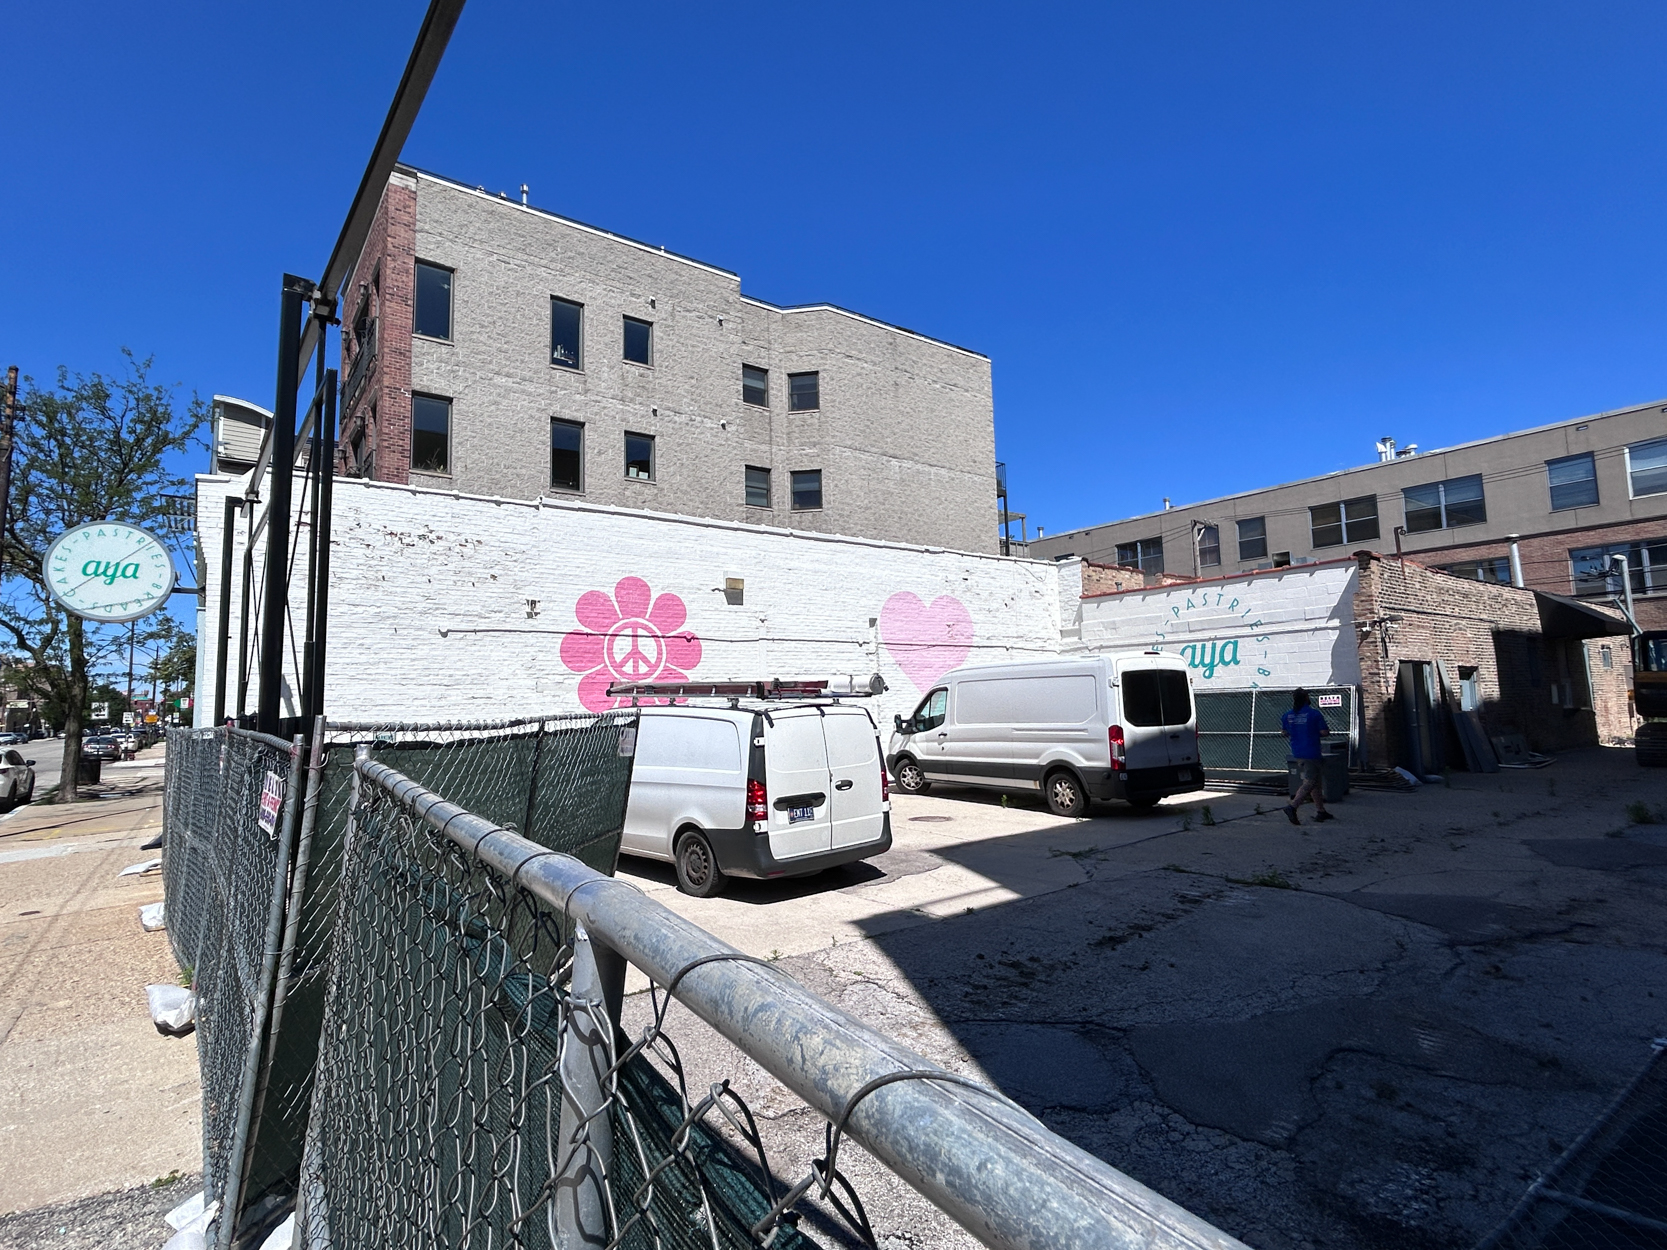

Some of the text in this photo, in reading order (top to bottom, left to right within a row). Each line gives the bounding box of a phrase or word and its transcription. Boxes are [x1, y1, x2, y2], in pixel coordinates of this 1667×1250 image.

[82, 528, 166, 569] PASTRIES
[53, 545, 76, 597] CAKES
[81, 559, 140, 586] aya
[91, 582, 162, 613] BREADS
[1171, 592, 1270, 643] PASTRIES
[1180, 639, 1240, 679] aya
